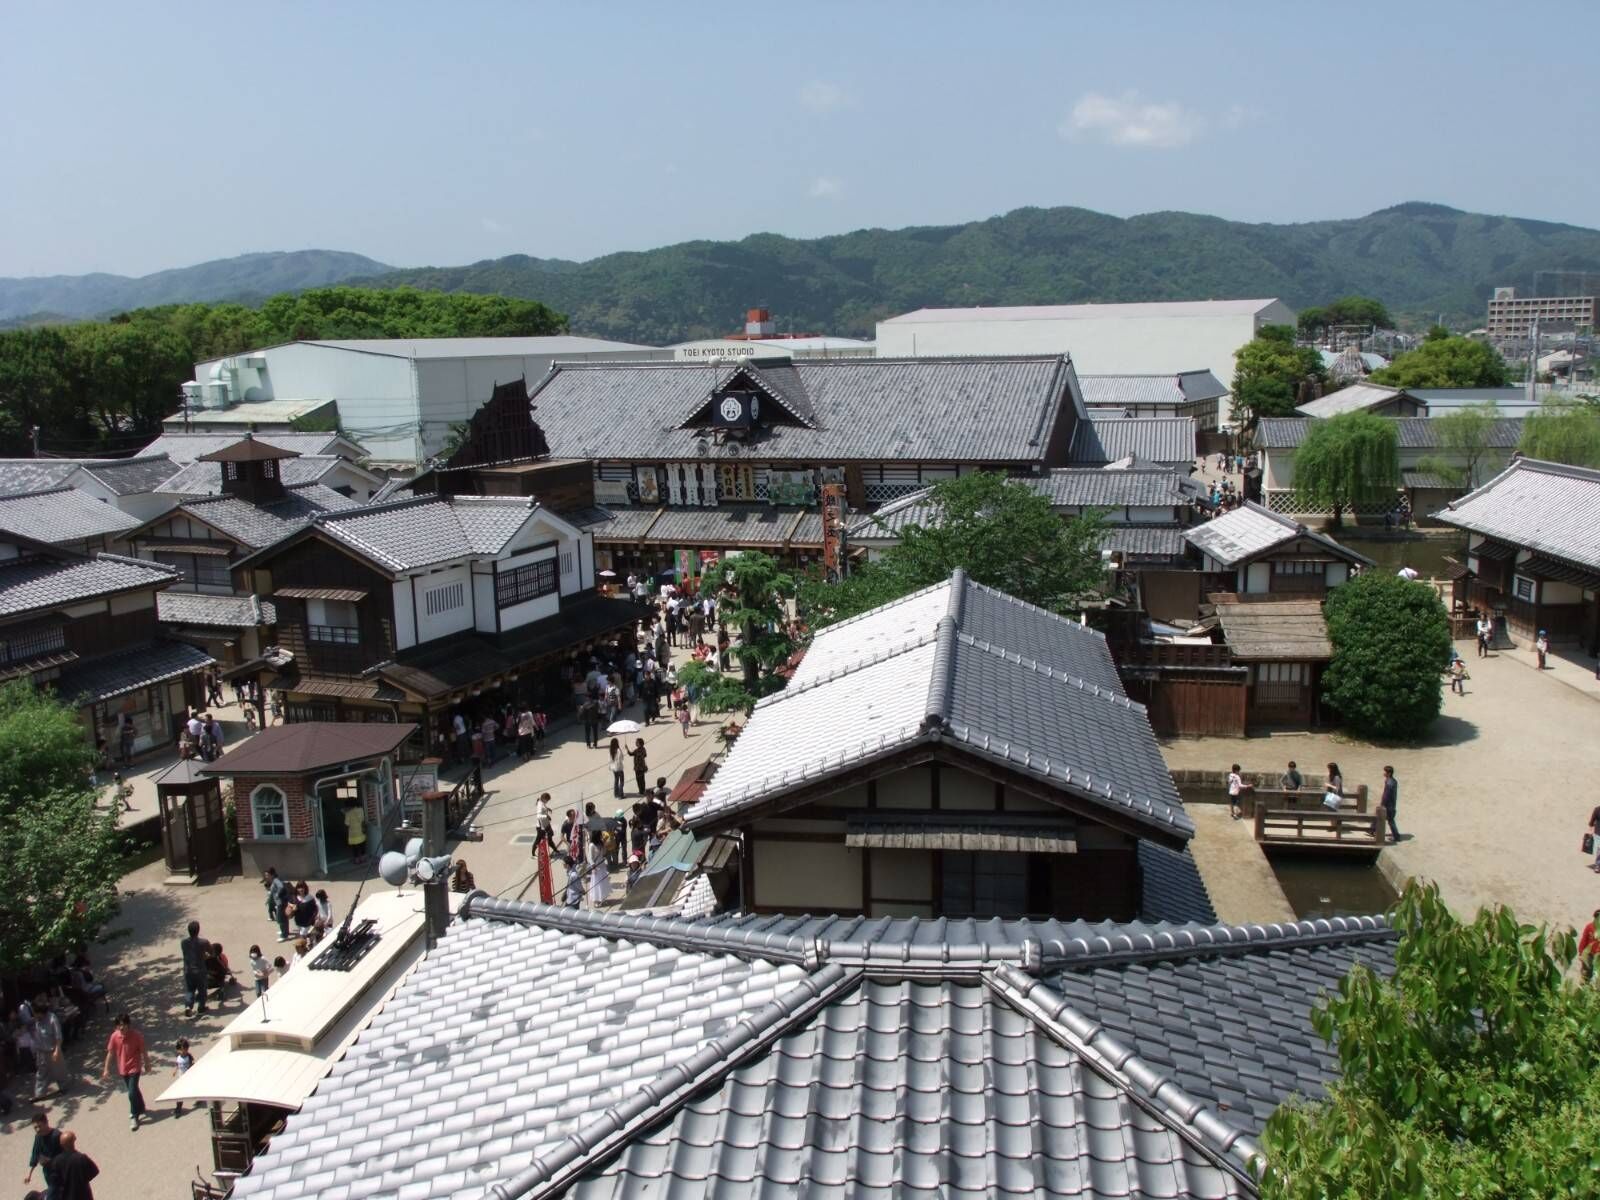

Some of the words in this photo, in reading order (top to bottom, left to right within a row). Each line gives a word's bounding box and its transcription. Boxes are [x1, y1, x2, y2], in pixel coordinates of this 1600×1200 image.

[683, 349, 700, 357] TOEI
[702, 348, 725, 357] KYOTO
[727, 348, 754, 356] STUDIO
